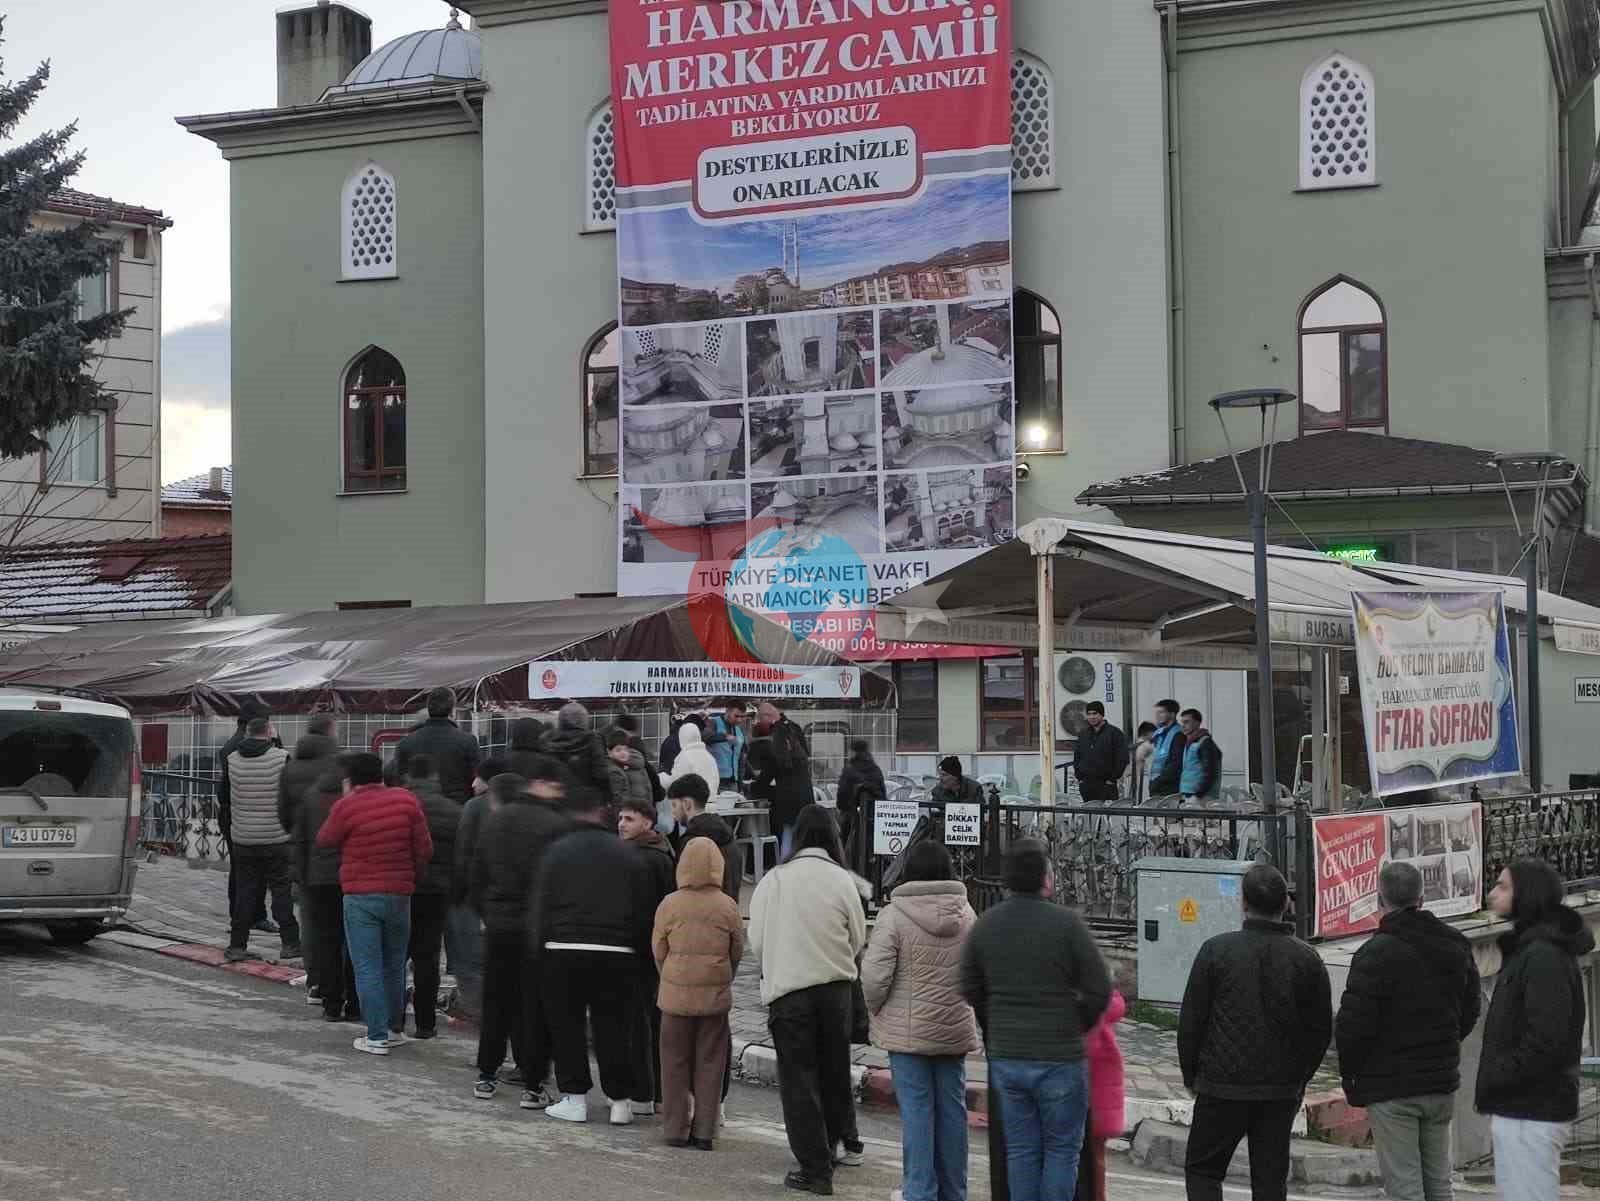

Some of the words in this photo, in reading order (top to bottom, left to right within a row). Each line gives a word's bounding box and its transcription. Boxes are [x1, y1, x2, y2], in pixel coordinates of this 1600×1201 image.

[646, 0, 970, 48] HARMAN
[622, 38, 829, 100] MERKEZ
[839, 4, 998, 71] CAMİİ
[637, 98, 774, 127] TADİLATINA
[777, 66, 987, 109] YARDIMLARINIZI
[731, 103, 880, 138] BEKLİYORUZ
[705, 138, 909, 178] DESTEKLERİNİZLE
[733, 170, 880, 203] ONARILACAK
[698, 568, 777, 587] TÜRKİYE
[784, 563, 867, 583] DİYANET
[873, 560, 929, 579] VAKFI
[724, 590, 831, 609] ARMANCIK
[1305, 619, 1345, 641] BURSA
[610, 681, 651, 694] TÜRKİYE
[655, 681, 698, 693] DİYANET
[731, 683, 783, 695] HARMANCIK
[785, 684, 814, 696] ŞUBESİ
[648, 667, 708, 680] HARMANCIK
[1104, 662, 1114, 703] BEKO
[1375, 701, 1424, 752] İFTAR
[1430, 701, 1493, 747] SOFRASI
[947, 812, 978, 823] DİKKAT
[952, 824, 973, 834] ÇELİK
[12, 830, 27, 841] 43
[31, 829, 38, 841] U
[42, 829, 73, 841] 0796
[1323, 837, 1376, 880] GENÇLİK
[1323, 866, 1378, 913] MERKEZİ
